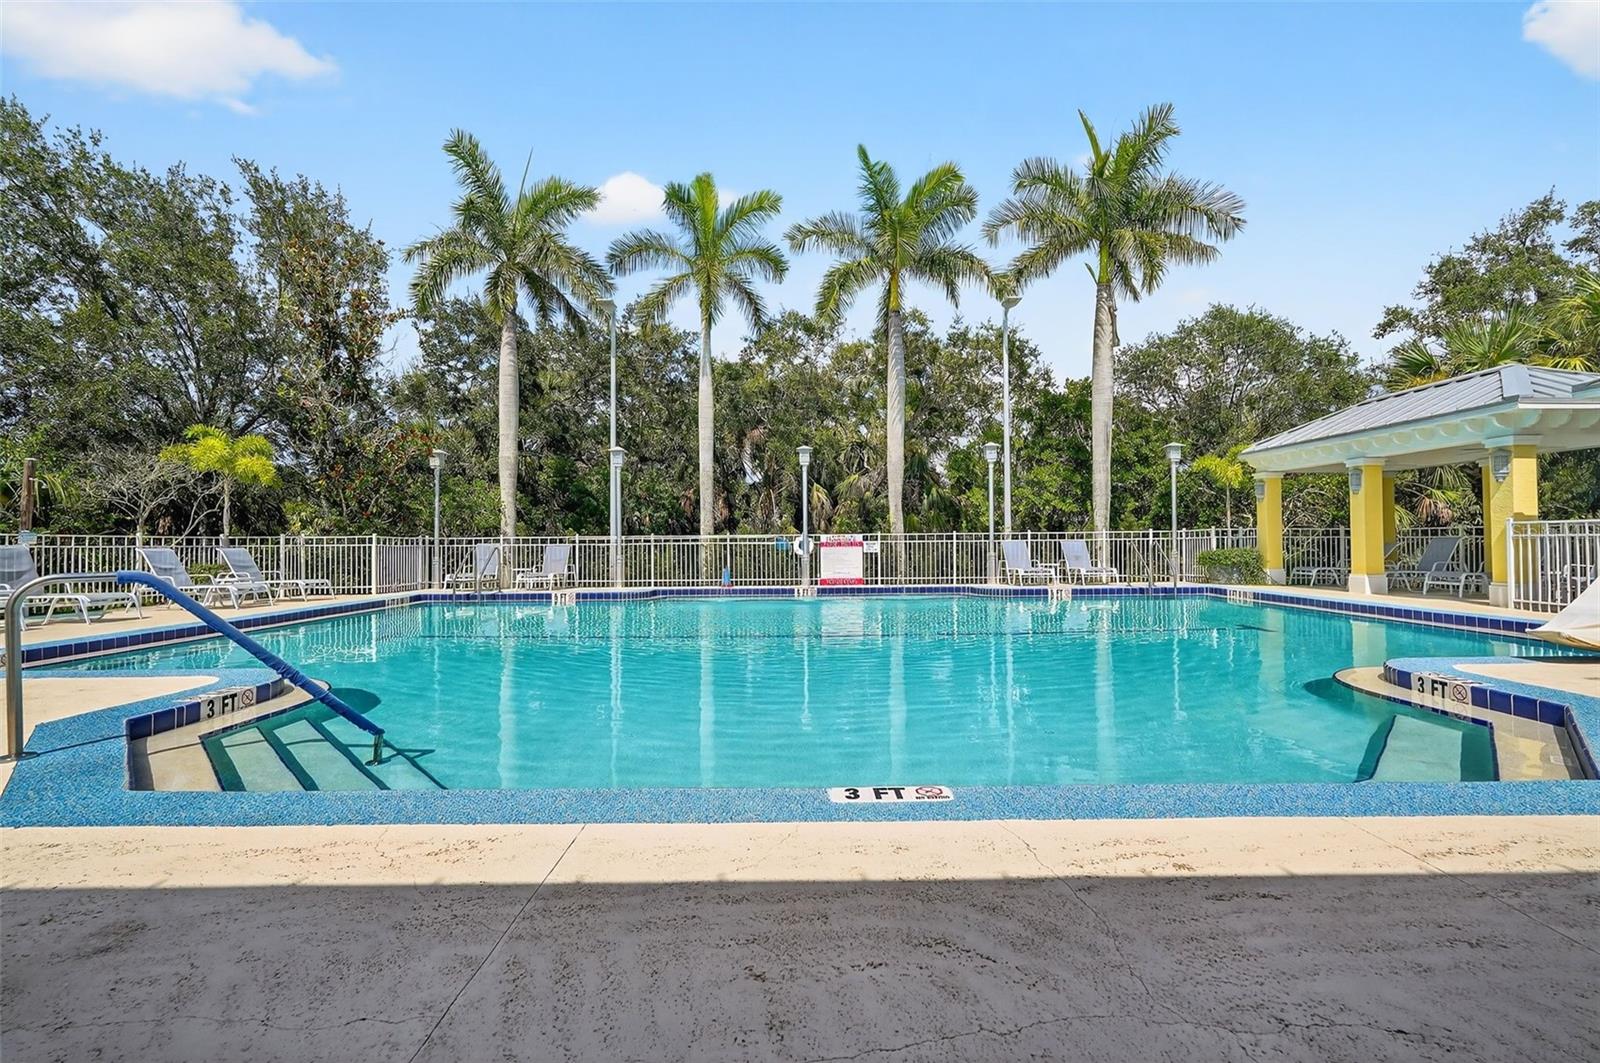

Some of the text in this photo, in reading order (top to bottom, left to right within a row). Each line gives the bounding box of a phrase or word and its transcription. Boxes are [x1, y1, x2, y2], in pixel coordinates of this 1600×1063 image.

[1417, 676, 1448, 698] 3 FT
[207, 692, 238, 719] 3 FT
[844, 787, 905, 800] 3 FT
